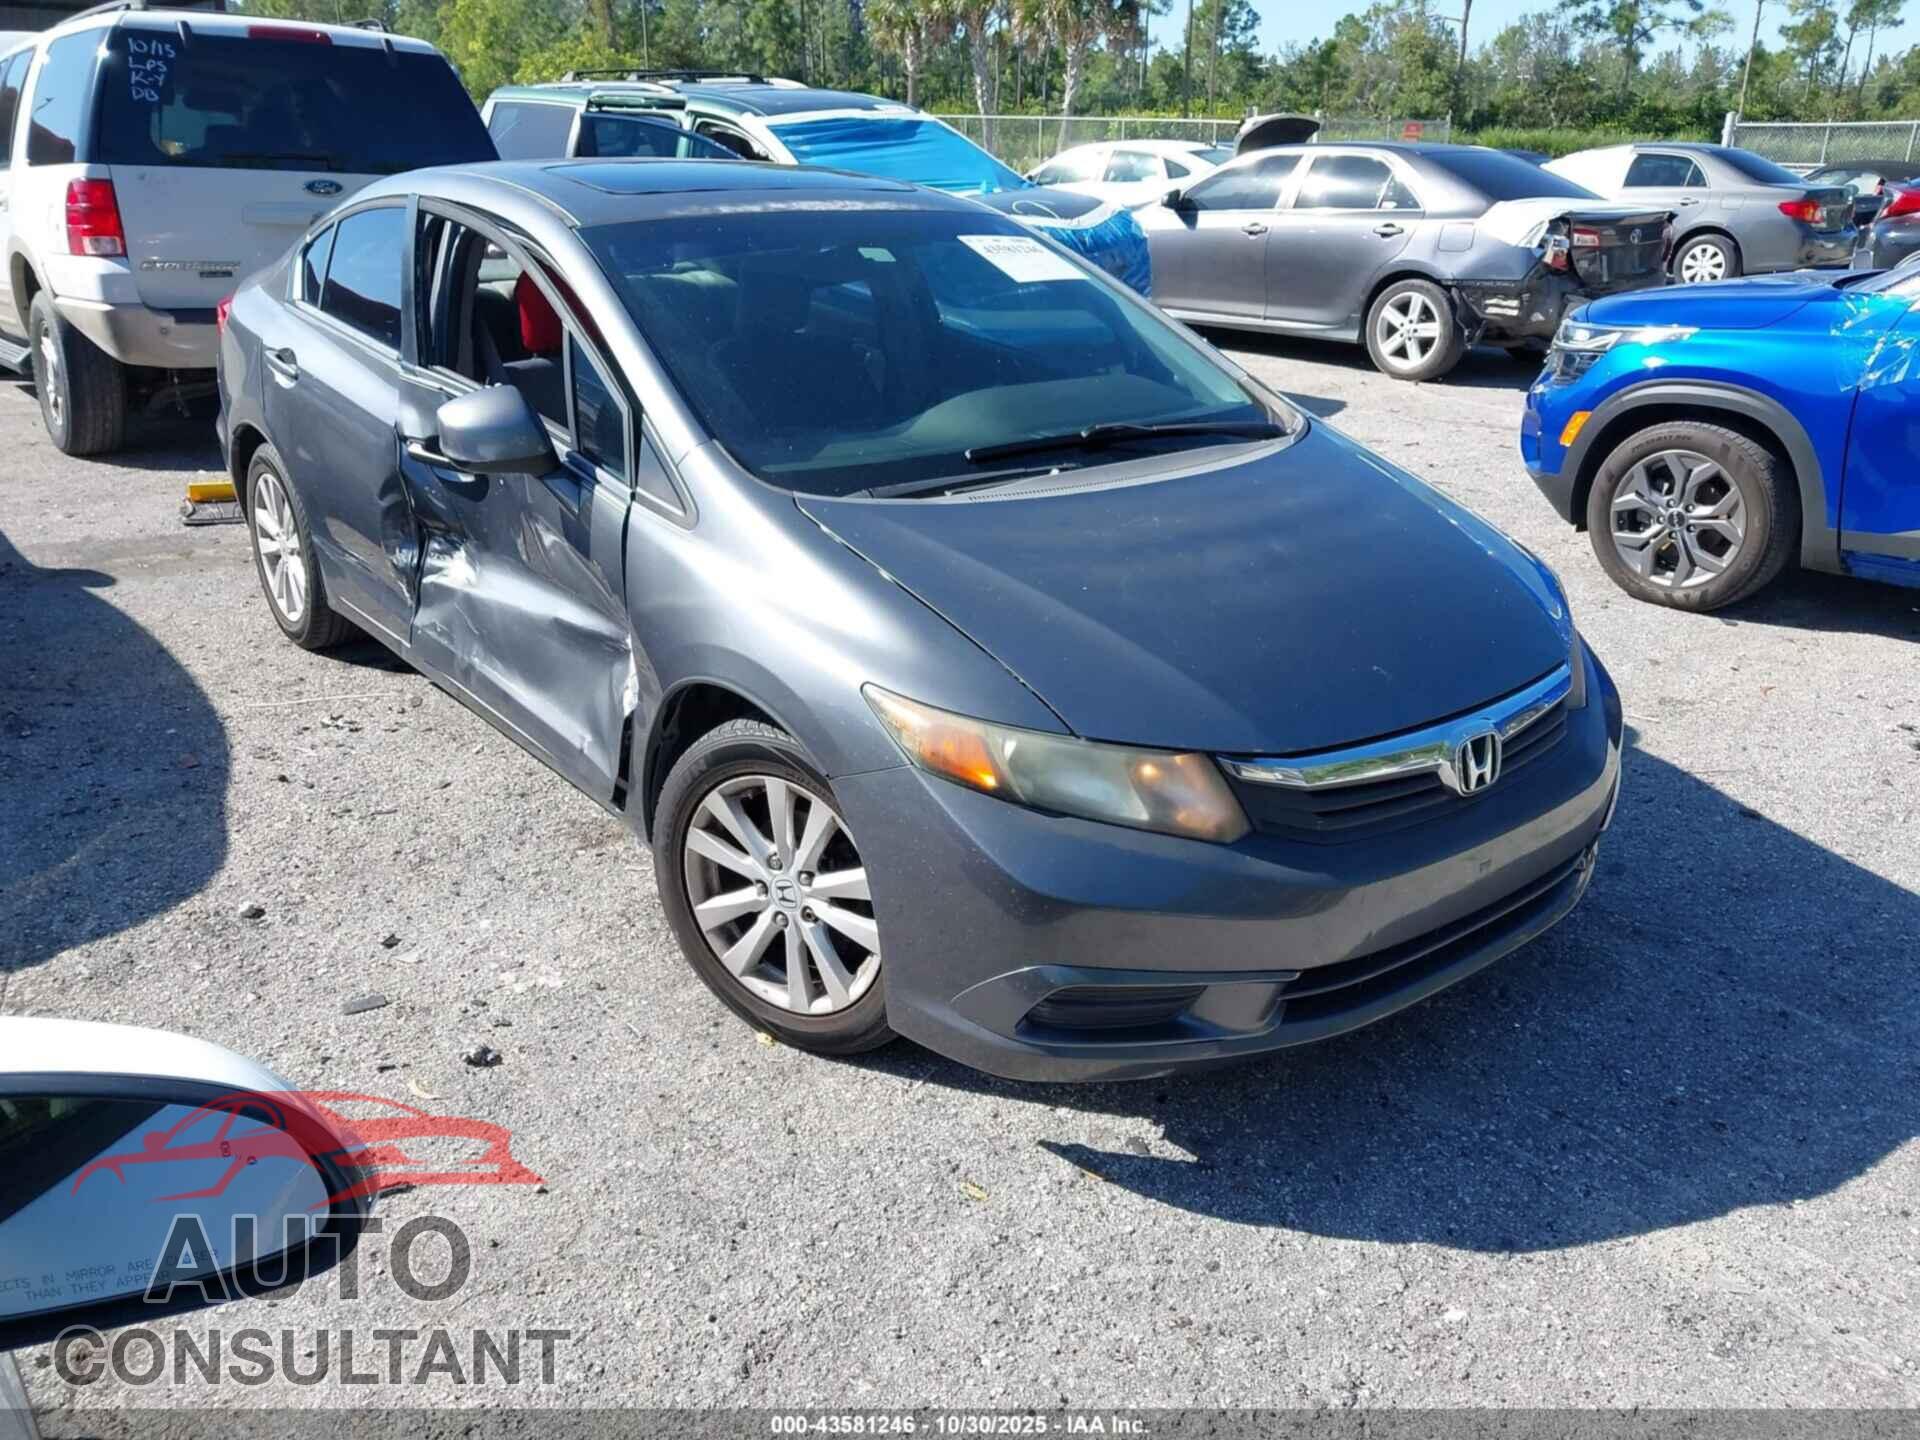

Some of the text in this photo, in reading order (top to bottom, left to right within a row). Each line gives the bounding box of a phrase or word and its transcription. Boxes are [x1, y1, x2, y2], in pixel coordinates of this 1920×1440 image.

[65, 1263, 117, 1281] MIRROR
[127, 1257, 153, 1272] ARE
[24, 1286, 63, 1301] THAN
[72, 1279, 107, 1295] THEY
